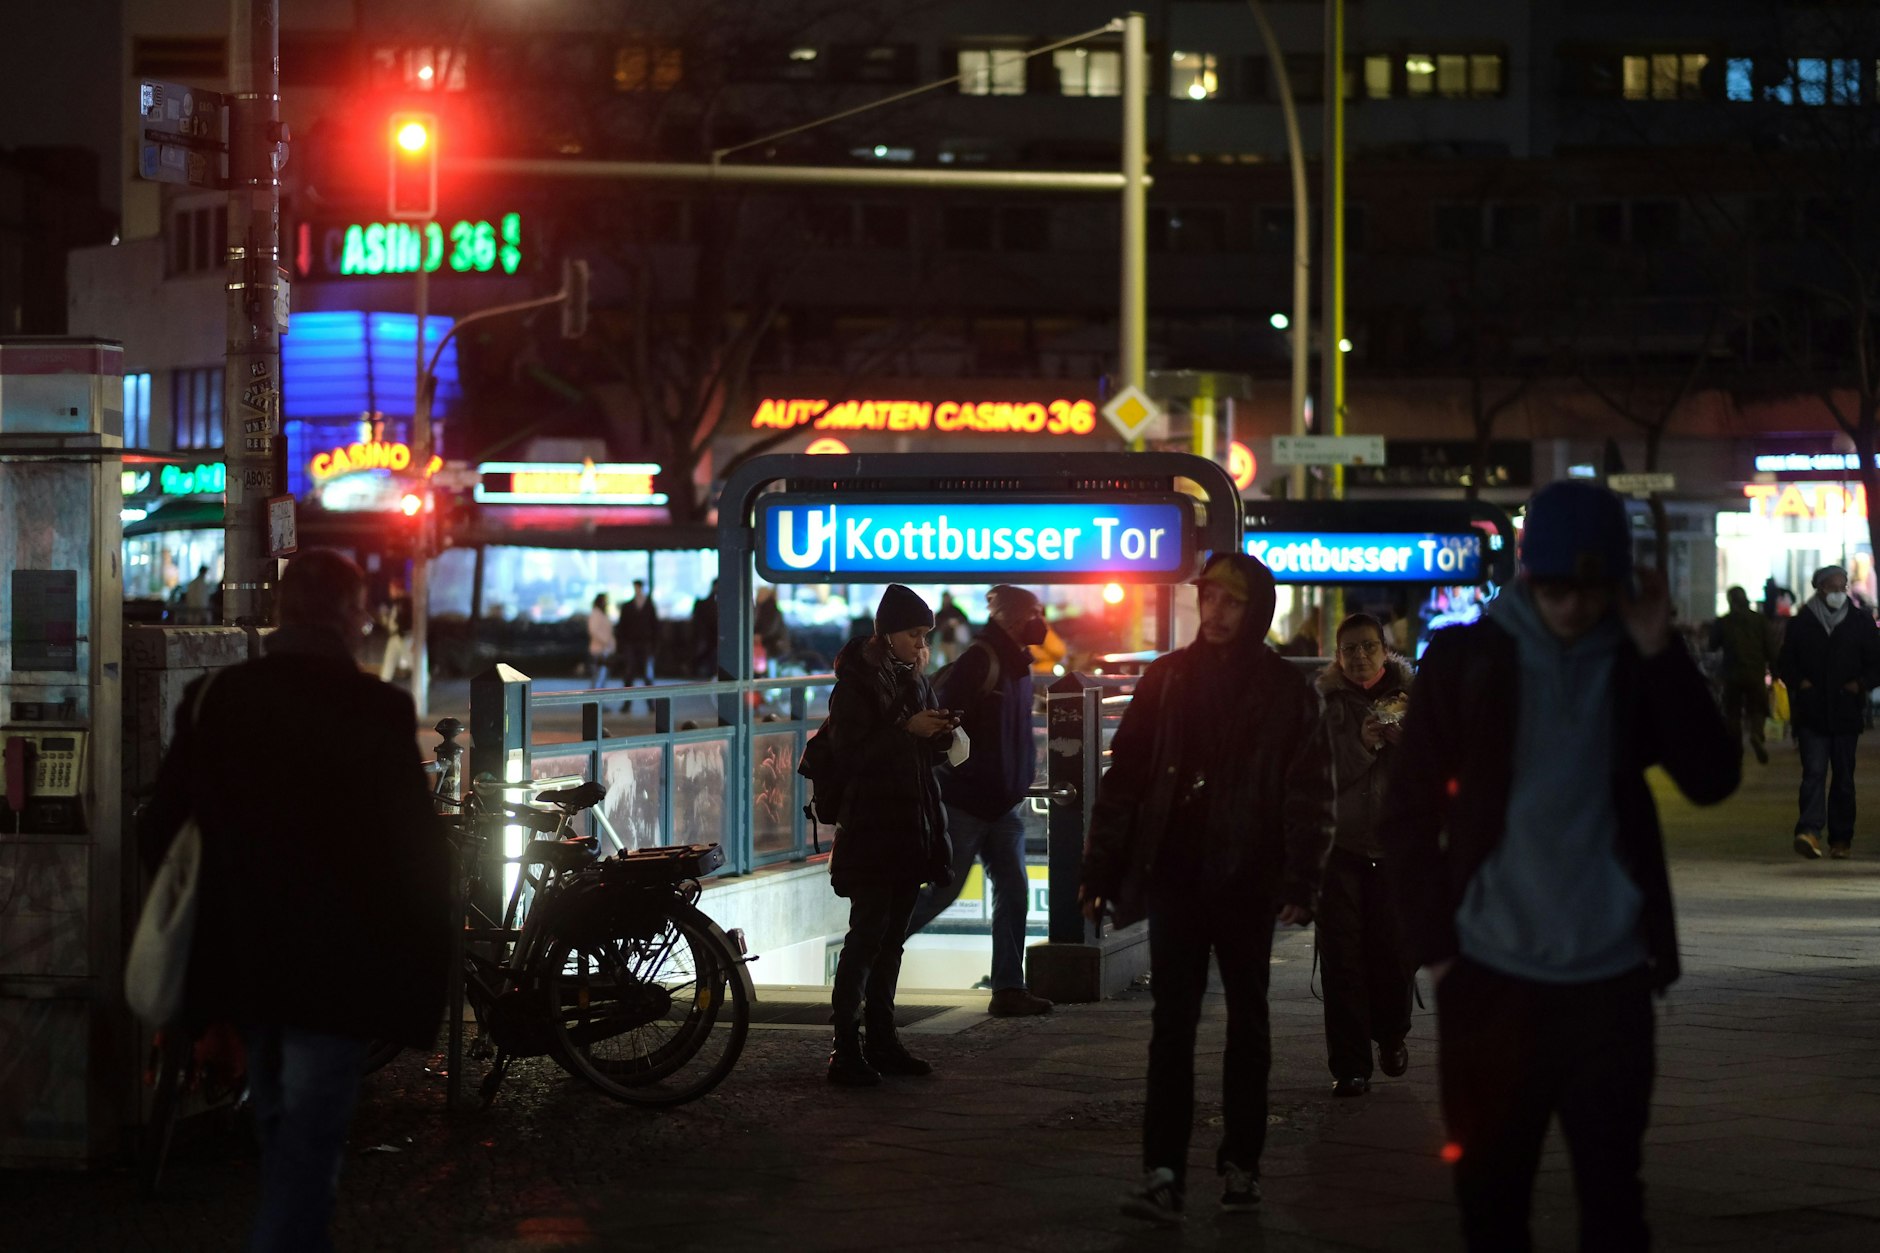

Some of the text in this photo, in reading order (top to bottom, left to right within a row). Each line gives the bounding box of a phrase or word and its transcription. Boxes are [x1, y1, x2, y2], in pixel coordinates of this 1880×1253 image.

[933, 400, 1048, 433] CASINO
[1047, 399, 1097, 435] 36
[311, 441, 411, 480] CASINO
[777, 509, 1166, 569] U Kottbusser Tor
[1247, 538, 1413, 573] Kottbusser
[1418, 540, 1469, 573] Tor
